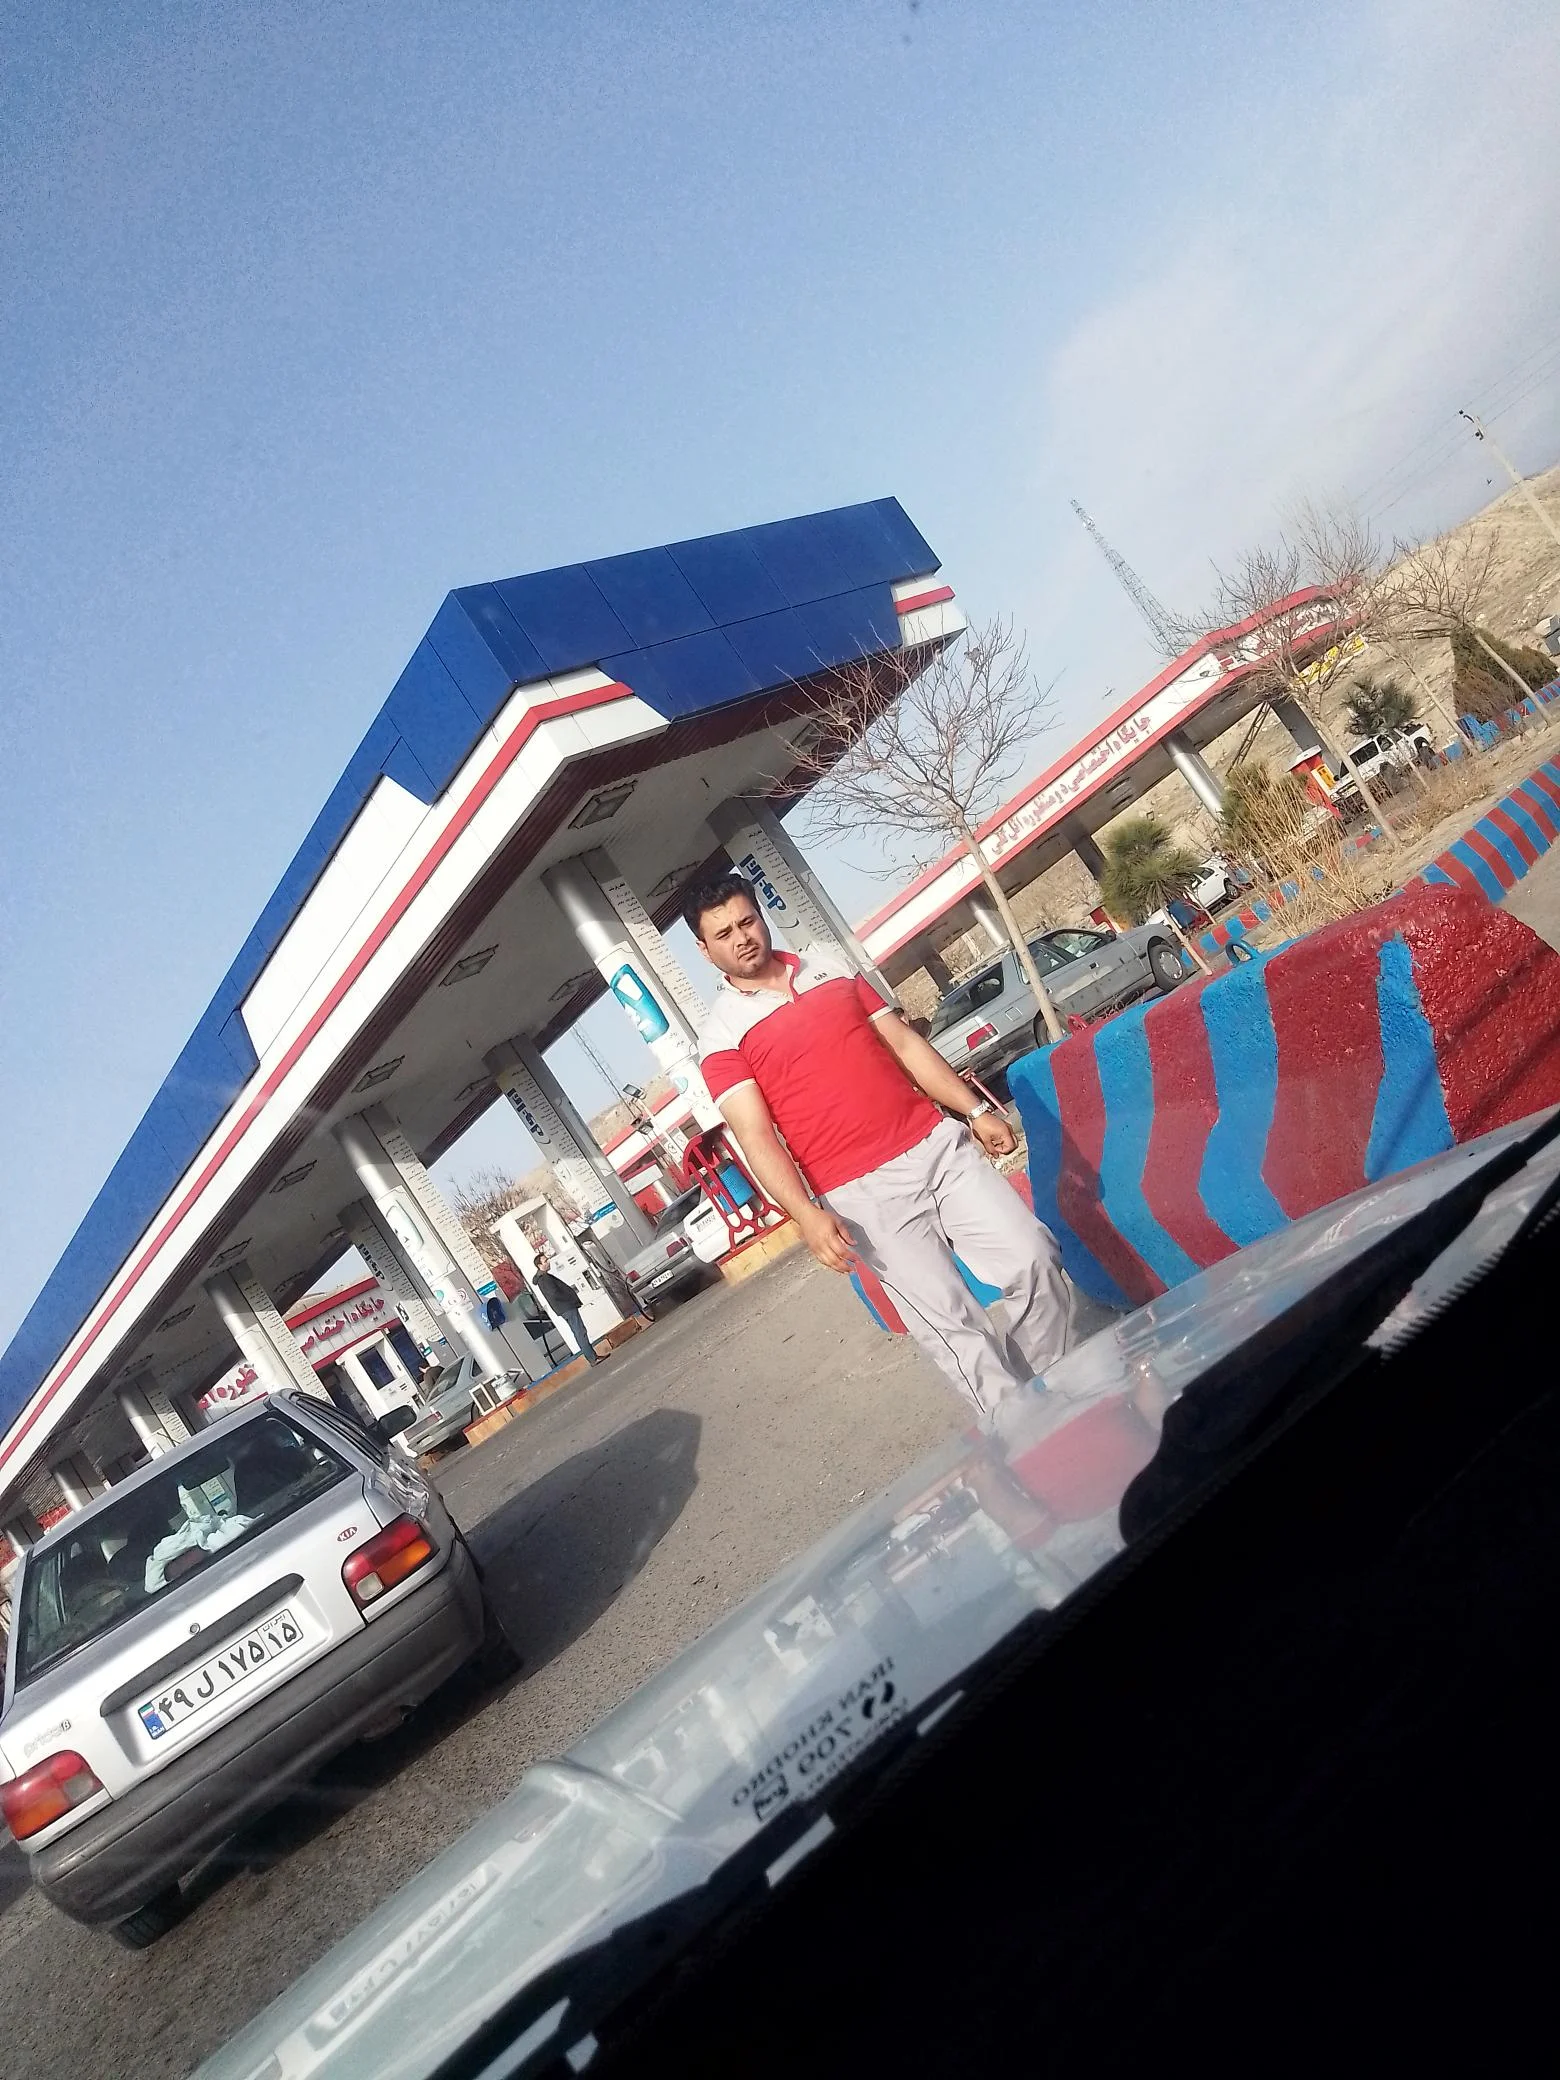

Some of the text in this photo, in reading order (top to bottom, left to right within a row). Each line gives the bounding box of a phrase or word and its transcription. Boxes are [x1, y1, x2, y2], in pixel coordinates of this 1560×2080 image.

[1112, 716, 1151, 752] جایگاه
[1068, 739, 1115, 793] اختصاصی
[351, 1297, 386, 1322] جایگاه
[338, 1527, 357, 1541] KIA
[262, 1613, 287, 1632] ایران
[158, 1622, 298, 1722] ۴۹ ل ۱۷۵ ۱۵
